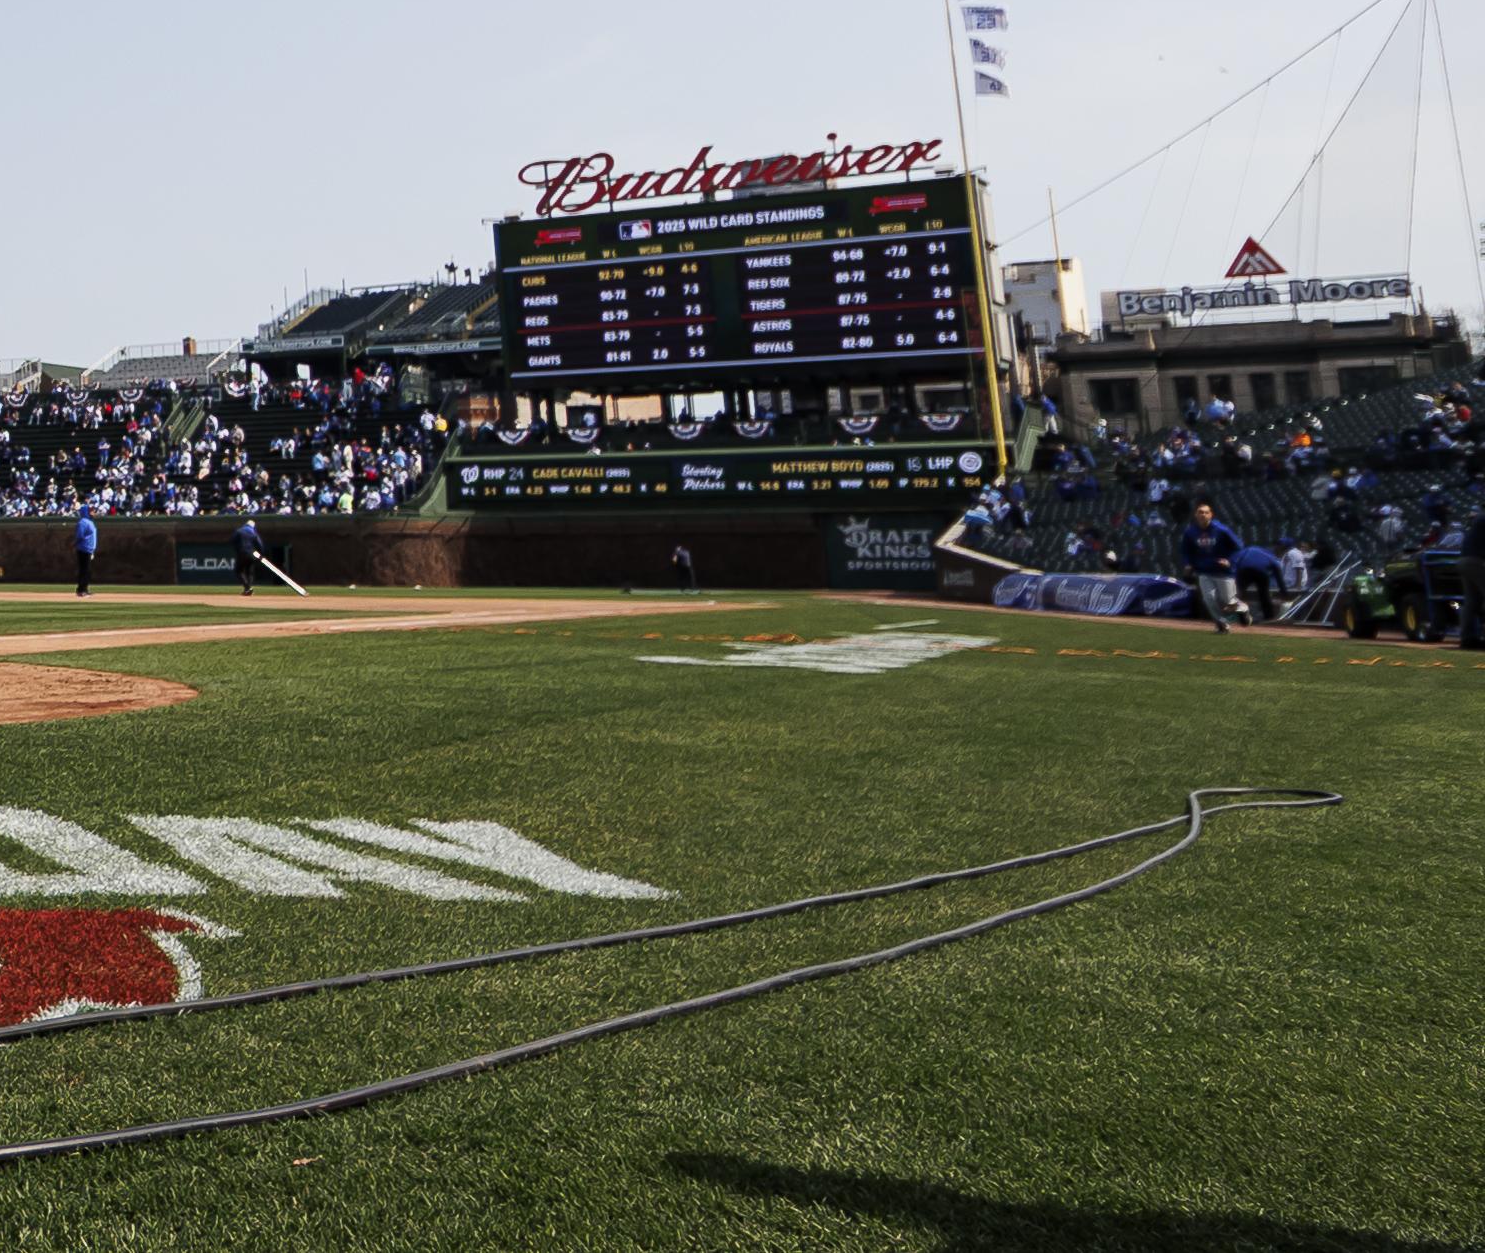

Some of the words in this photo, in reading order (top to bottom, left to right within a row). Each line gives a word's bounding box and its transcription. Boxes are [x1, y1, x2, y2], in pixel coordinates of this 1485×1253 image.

[518, 133, 942, 217] Budweiser
[657, 218, 685, 234] 2025
[687, 216, 717, 231] WILD
[720, 212, 753, 228] CARD
[756, 205, 824, 225] STANDINGS
[746, 254, 792, 269] YANKEES
[928, 242, 946, 254] 9-1
[522, 276, 546, 287] CUBS
[748, 278, 768, 290] RED
[769, 276, 790, 289] SOX
[930, 264, 950, 277] 6-4
[523, 295, 559, 307] PADRES
[683, 283, 699, 295] 7-3
[750, 298, 786, 312] TIGERS
[838, 292, 868, 306] 87-75
[933, 286, 952, 299] 2-8
[1118, 282, 1279, 316] Benjamin
[1288, 278, 1411, 303] Moore
[525, 316, 549, 327] REDS
[602, 310, 629, 322] 83-79
[752, 319, 792, 333] ASTROS
[840, 314, 870, 327] 87-75
[527, 335, 551, 347] METS
[604, 329, 631, 342] 83-79
[687, 325, 704, 337] 5-5
[754, 341, 794, 354] ROYALS
[896, 334, 915, 346] 5.0
[938, 331, 958, 343] 6-4
[528, 355, 561, 368] GIANTS
[653, 348, 669, 360] 2.0
[689, 346, 706, 358] 5-5
[484, 468, 506, 480] RHP
[508, 467, 524, 481] 24
[532, 468, 559, 479] CADE
[561, 466, 604, 479] CAVALLI
[772, 461, 829, 474] MATTHEW
[831, 460, 864, 472] BOYD
[928, 457, 954, 470] LHP
[849, 529, 932, 547] DRAFT
[857, 546, 931, 558] KINGS
